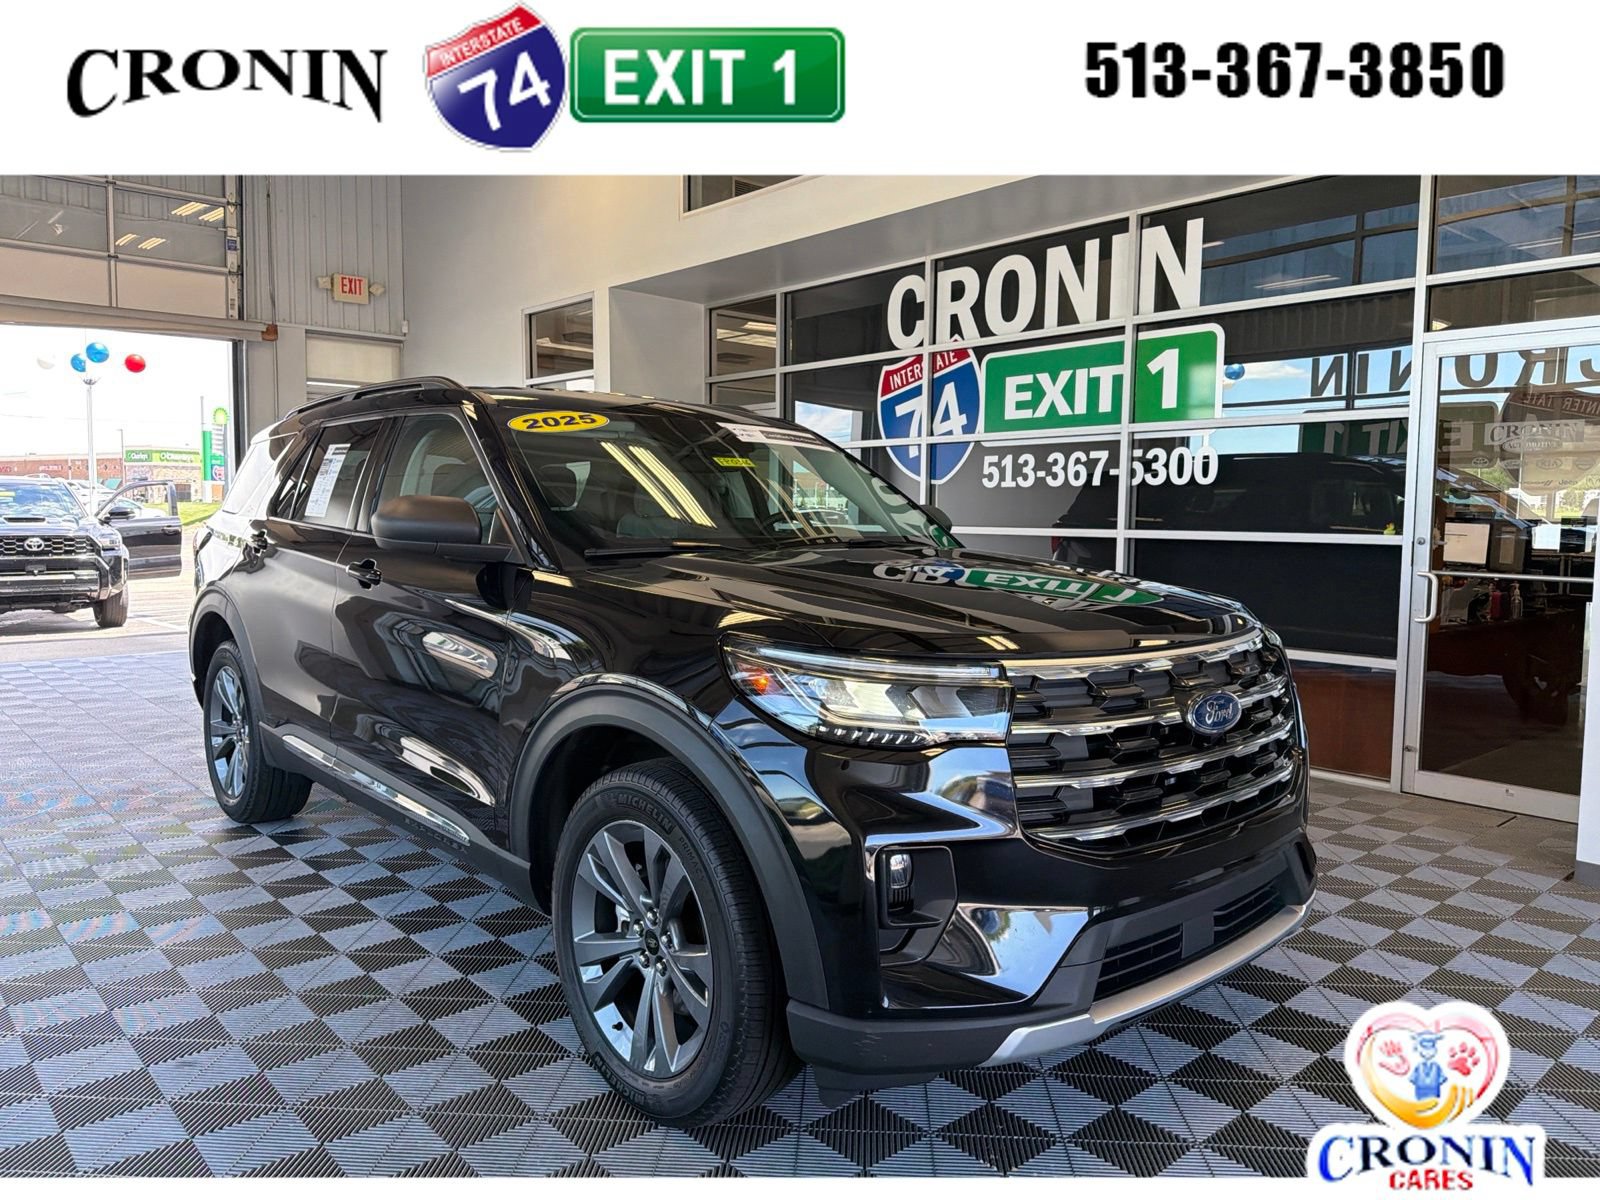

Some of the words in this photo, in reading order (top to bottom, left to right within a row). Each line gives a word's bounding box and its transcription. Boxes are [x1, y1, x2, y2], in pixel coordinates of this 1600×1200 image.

[340, 276, 364, 297] EXIT
[887, 217, 1204, 351] CRONIN
[889, 350, 958, 391] INTERATE
[1003, 363, 1125, 421] EXIT
[1146, 347, 1180, 411] 1
[522, 414, 597, 429] 2025
[894, 381, 968, 459] 74
[981, 446, 1219, 489] 513-367-5300
[1205, 699, 1233, 725] Ford
[616, 793, 673, 833] MICHELIN
